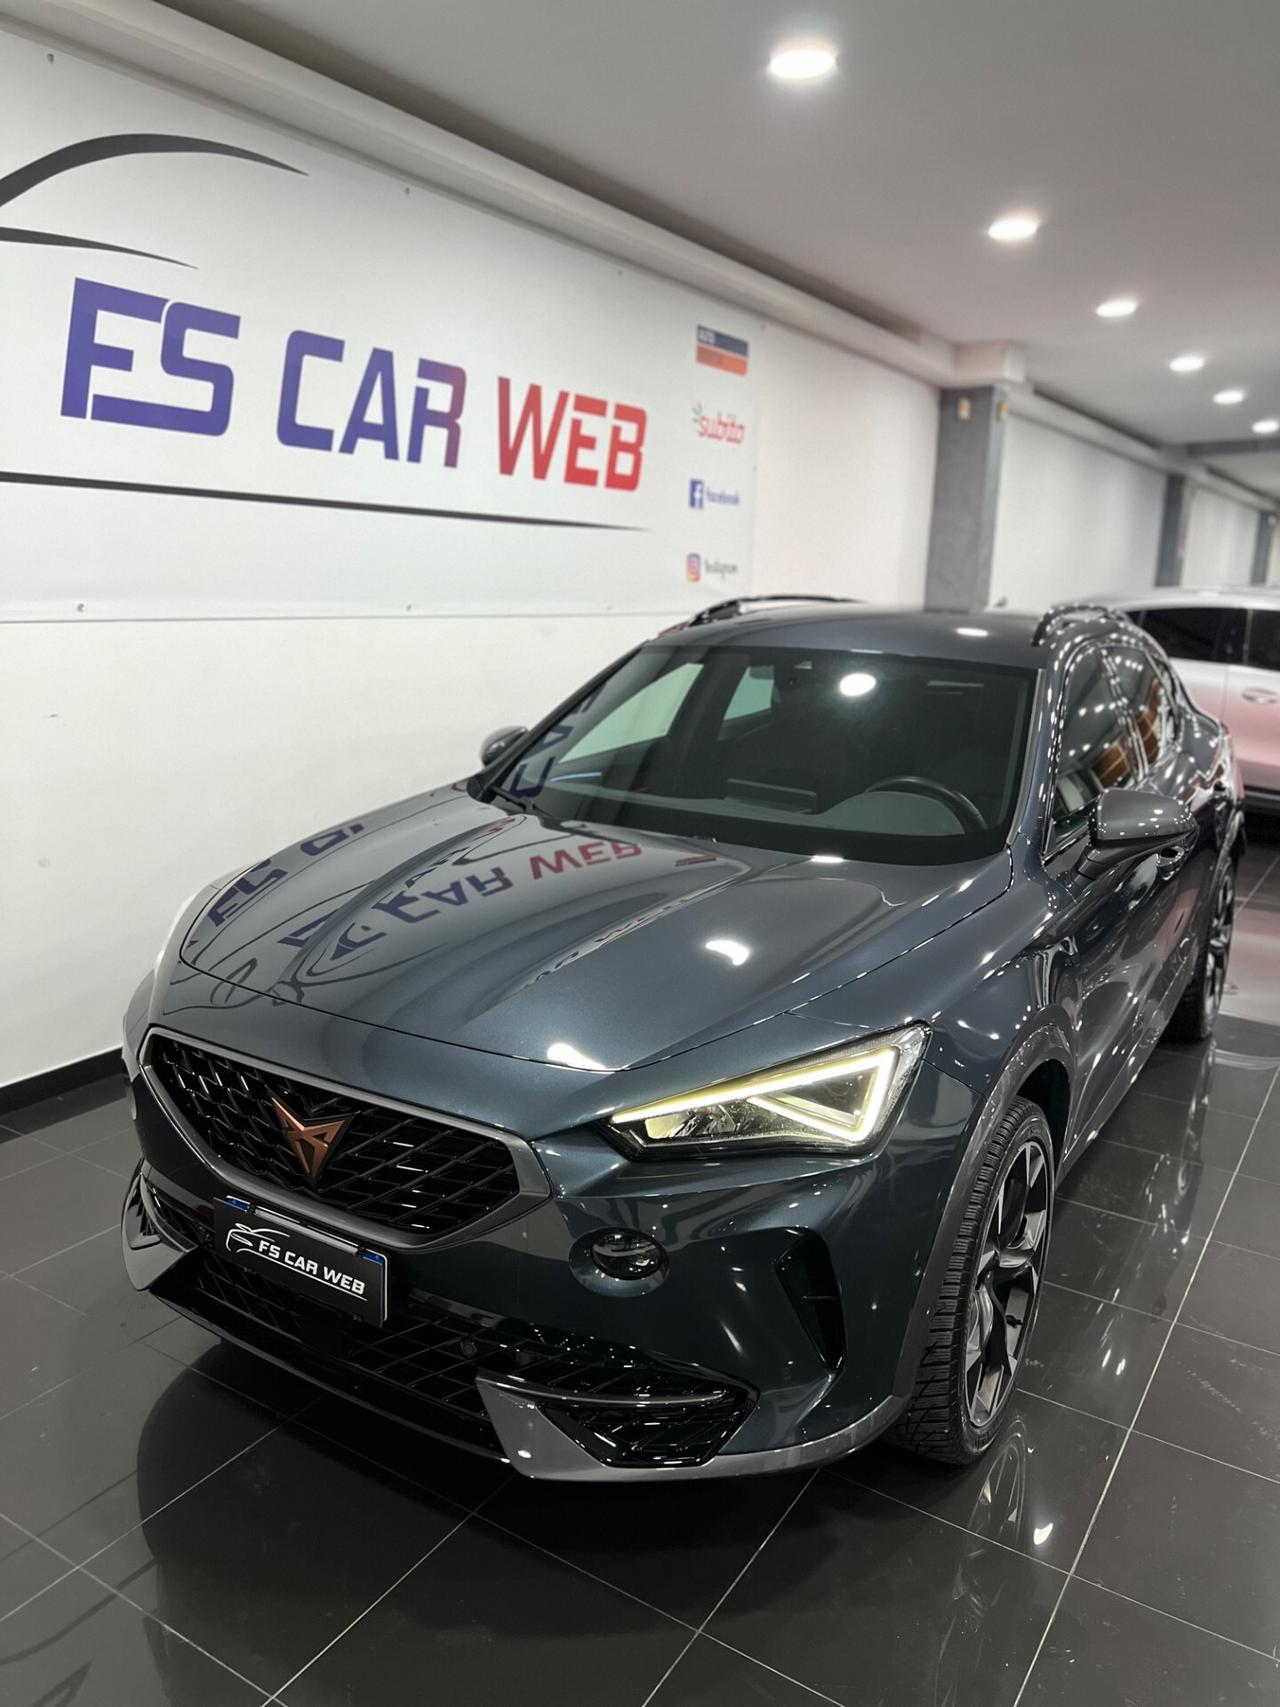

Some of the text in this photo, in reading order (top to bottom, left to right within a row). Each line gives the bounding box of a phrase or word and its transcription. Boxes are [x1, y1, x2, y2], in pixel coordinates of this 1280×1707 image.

[276, 329, 467, 468] CAR
[497, 375, 648, 492] WEB
[258, 1240, 365, 1295] FS CAR WEB
